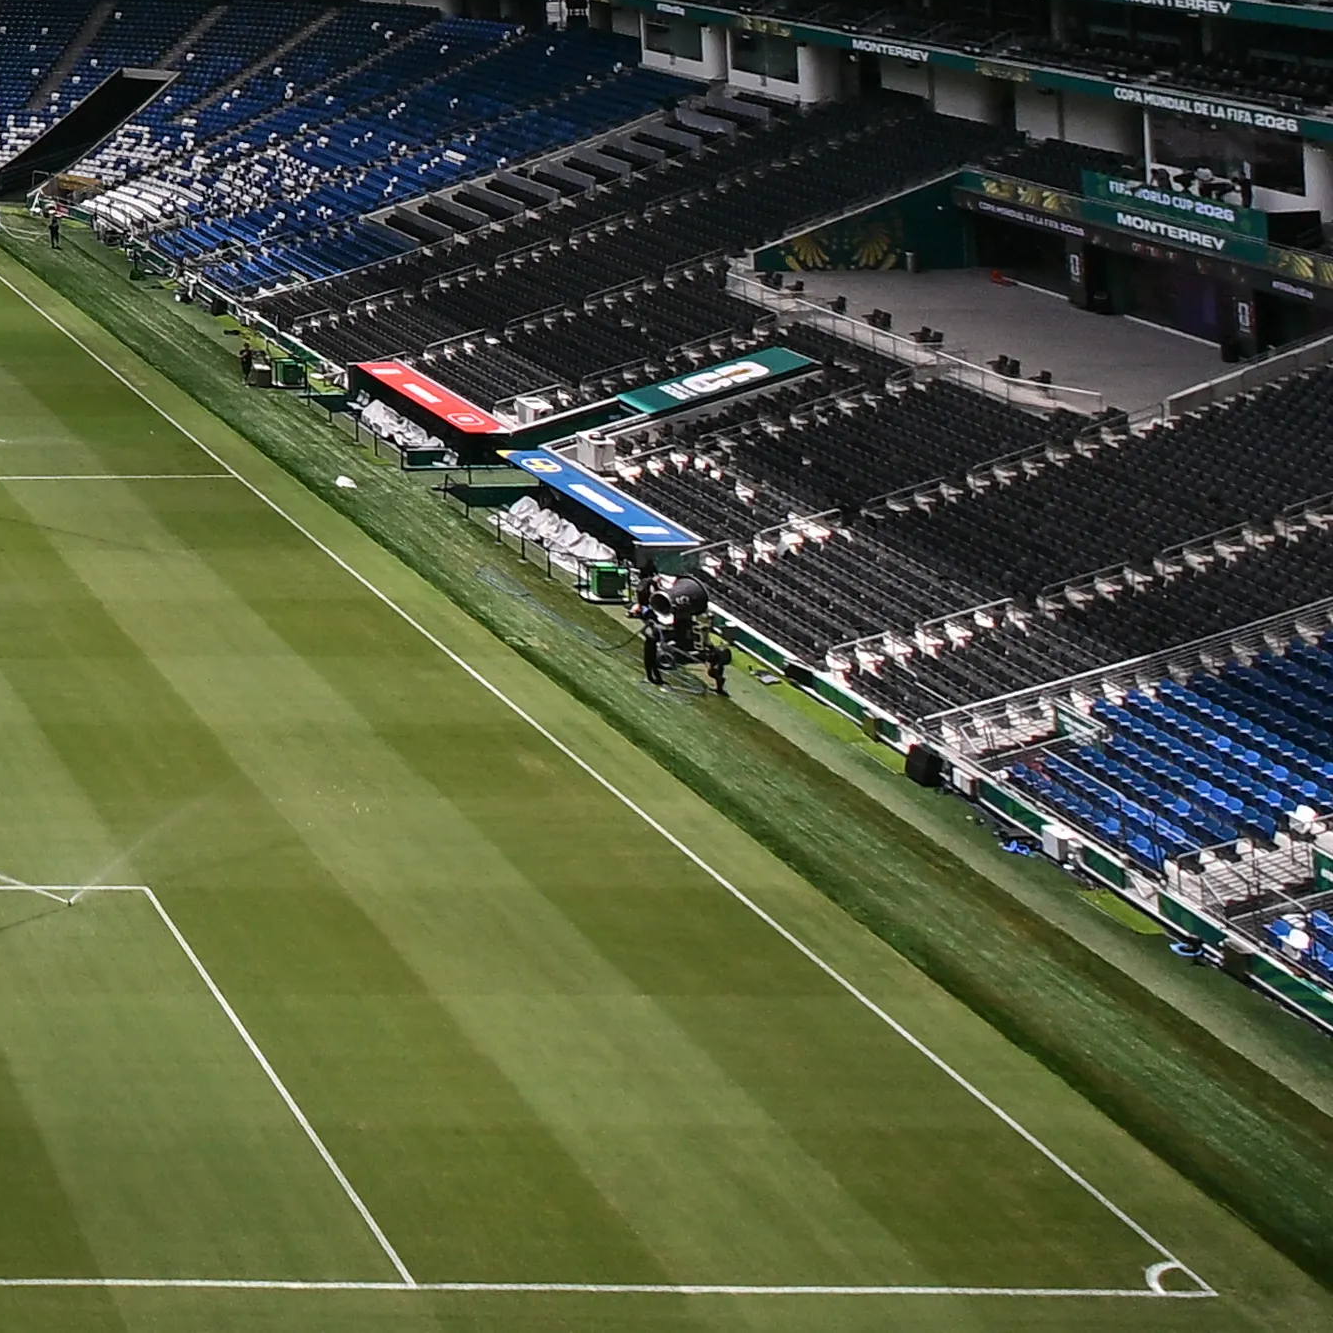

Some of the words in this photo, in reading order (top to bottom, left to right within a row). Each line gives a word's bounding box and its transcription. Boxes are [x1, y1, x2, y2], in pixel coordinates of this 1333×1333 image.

[851, 38, 930, 63] MONTERREY
[1113, 86, 1142, 104] COPA
[1143, 91, 1193, 114] MUNDIAL
[1193, 100, 1209, 117] DE
[1210, 104, 1227, 120] LA
[1227, 107, 1253, 125] FIFA
[1253, 113, 1299, 133] 2026
[1173, 196, 1194, 211] CUP
[1194, 201, 1235, 222] 2026
[1116, 212, 1226, 251] MONTERREY
